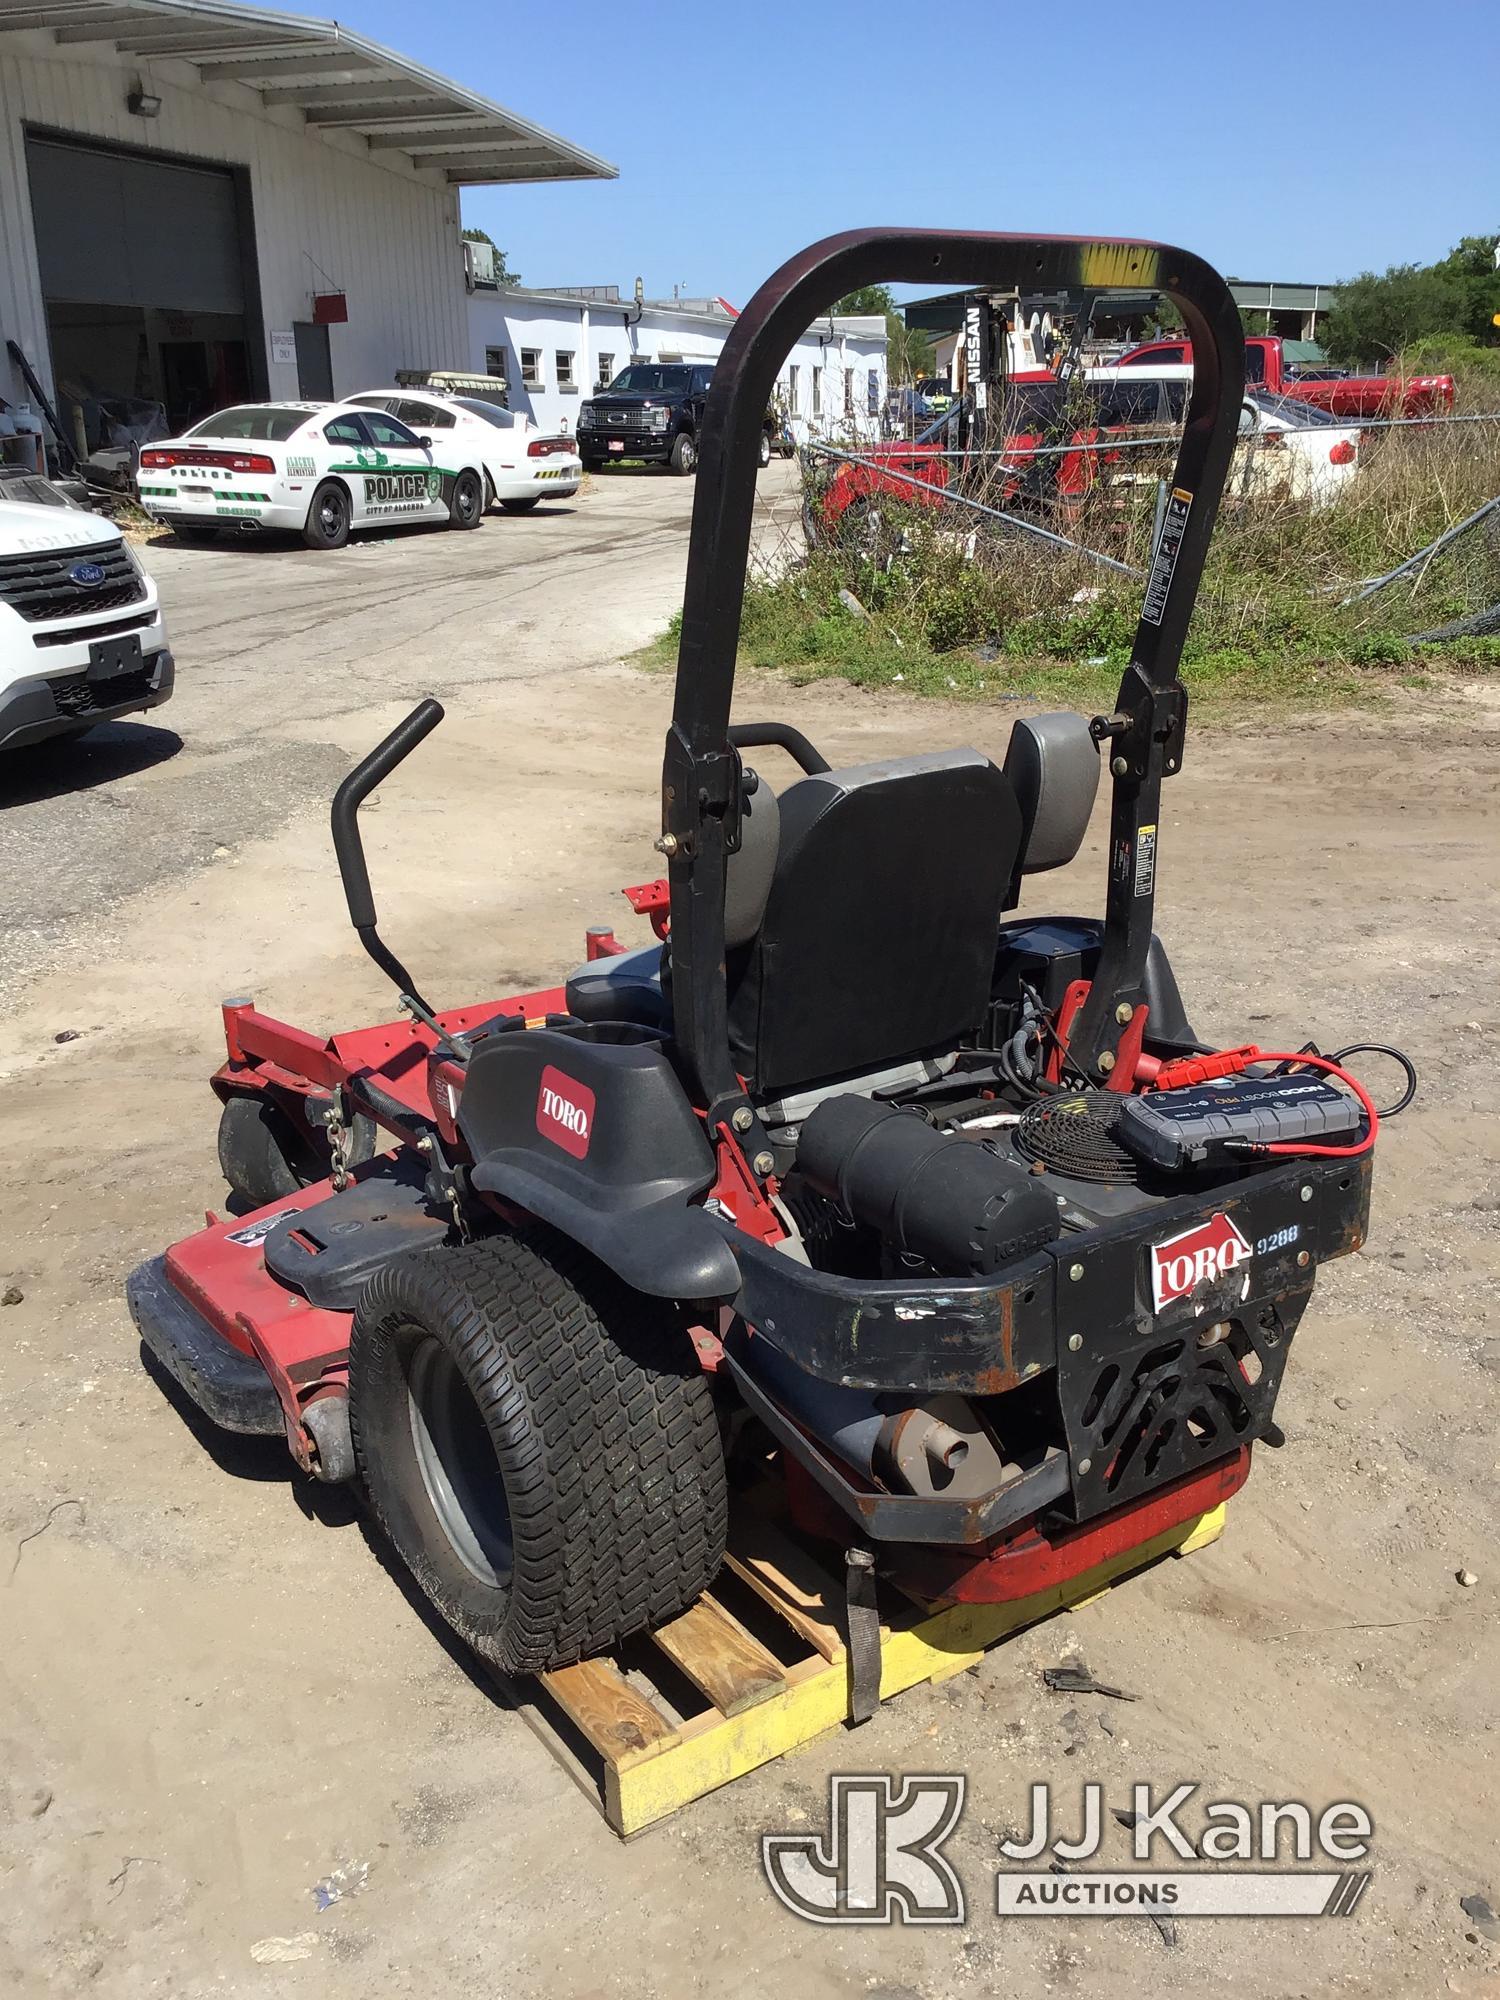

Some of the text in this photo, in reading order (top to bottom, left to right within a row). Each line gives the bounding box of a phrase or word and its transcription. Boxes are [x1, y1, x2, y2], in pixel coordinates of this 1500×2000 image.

[967, 307, 981, 383] NISSAN
[170, 468, 233, 480] POLICE
[364, 474, 425, 502] POLICE
[366, 503, 424, 515] CITY OF ALACHUA
[81, 567, 101, 580] Ford
[542, 1087, 587, 1136] TORO
[1257, 1225, 1298, 1255] 9288
